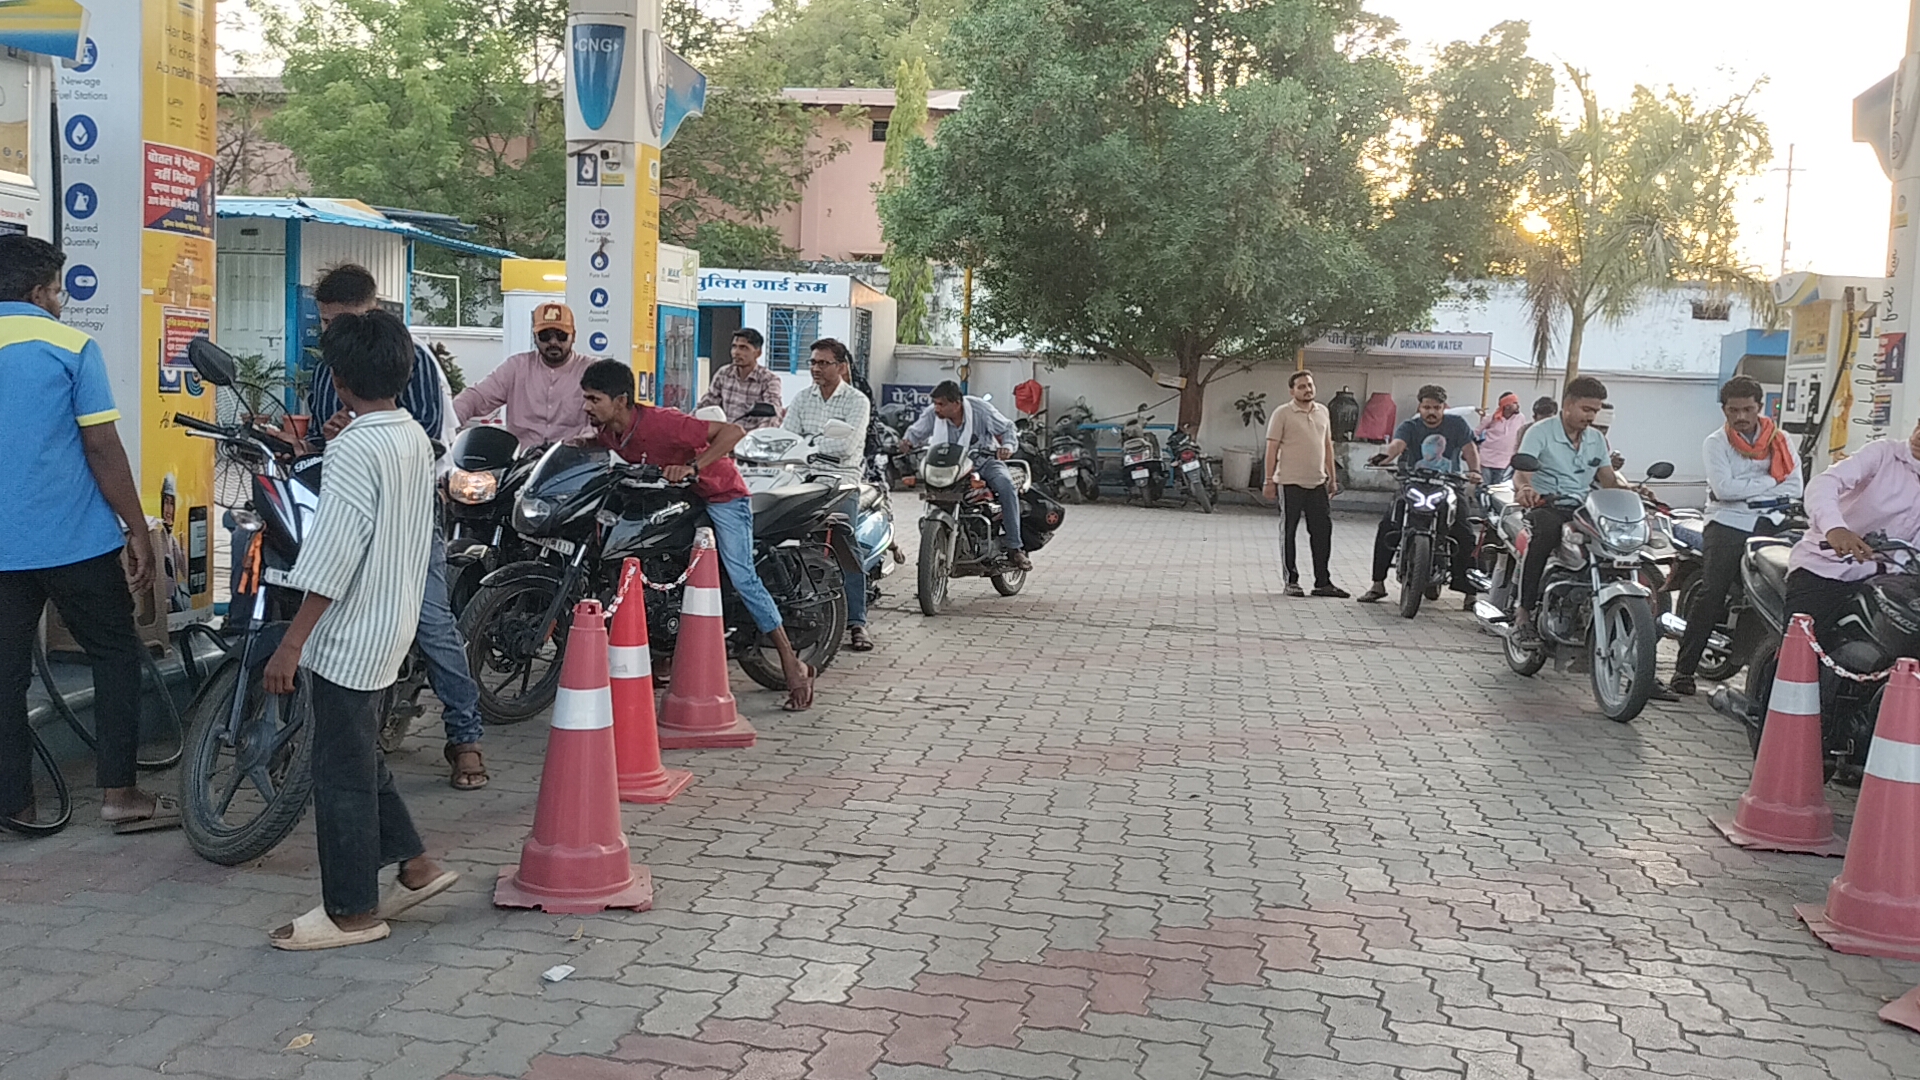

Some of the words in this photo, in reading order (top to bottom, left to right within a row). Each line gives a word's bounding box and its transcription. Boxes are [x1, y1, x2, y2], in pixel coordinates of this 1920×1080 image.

[578, 38, 613, 52] CNG
[61, 76, 101, 88] New-age
[74, 90, 108, 100] Stations
[63, 155, 82, 165] Pure
[84, 154, 100, 165] fuel
[64, 223, 98, 233] Assured
[62, 236, 100, 250] Quantity
[752, 277, 791, 291] गार्ड
[794, 281, 828, 294] रूम
[1400, 338, 1436, 350] DRINKING
[1438, 340, 1464, 350] WATER
